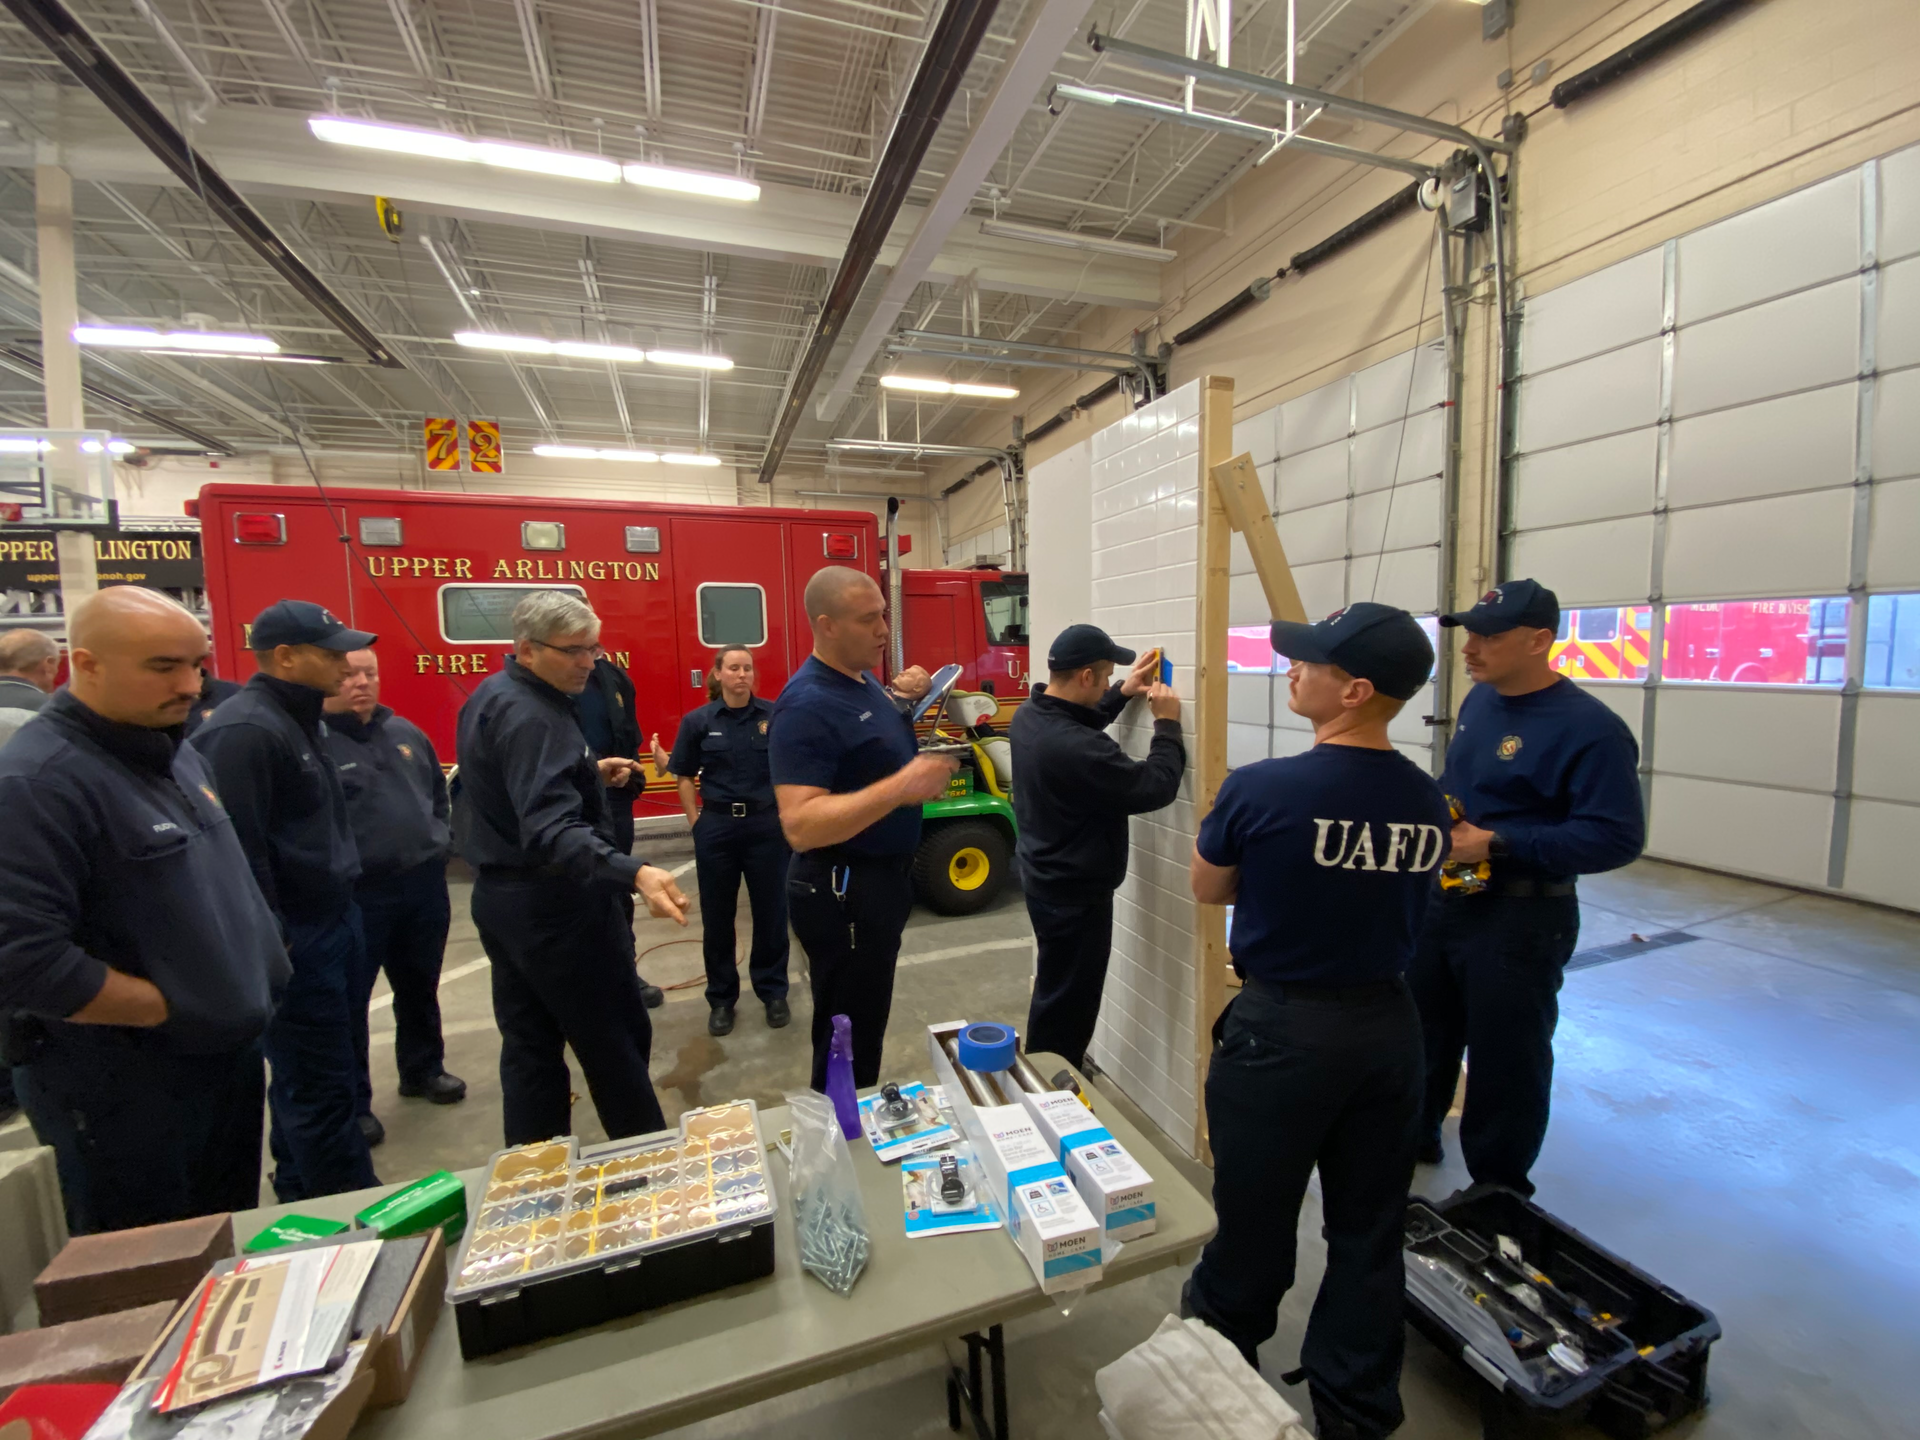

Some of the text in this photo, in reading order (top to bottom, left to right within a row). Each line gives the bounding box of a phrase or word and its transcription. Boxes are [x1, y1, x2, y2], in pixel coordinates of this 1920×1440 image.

[430, 429, 500, 463] 7 2
[0, 541, 192, 561] PPER LINGTON
[366, 556, 659, 581] UPPER ARLINGTON
[1752, 602, 1775, 614] FIRE
[416, 653, 489, 675] FIRE
[1313, 818, 1444, 872] UAFD
[1050, 1097, 1075, 1105] MOEN
[1005, 1126, 1032, 1136] MOEN
[1120, 1191, 1144, 1202] MOEN
[1059, 1236, 1086, 1249] MOEN
